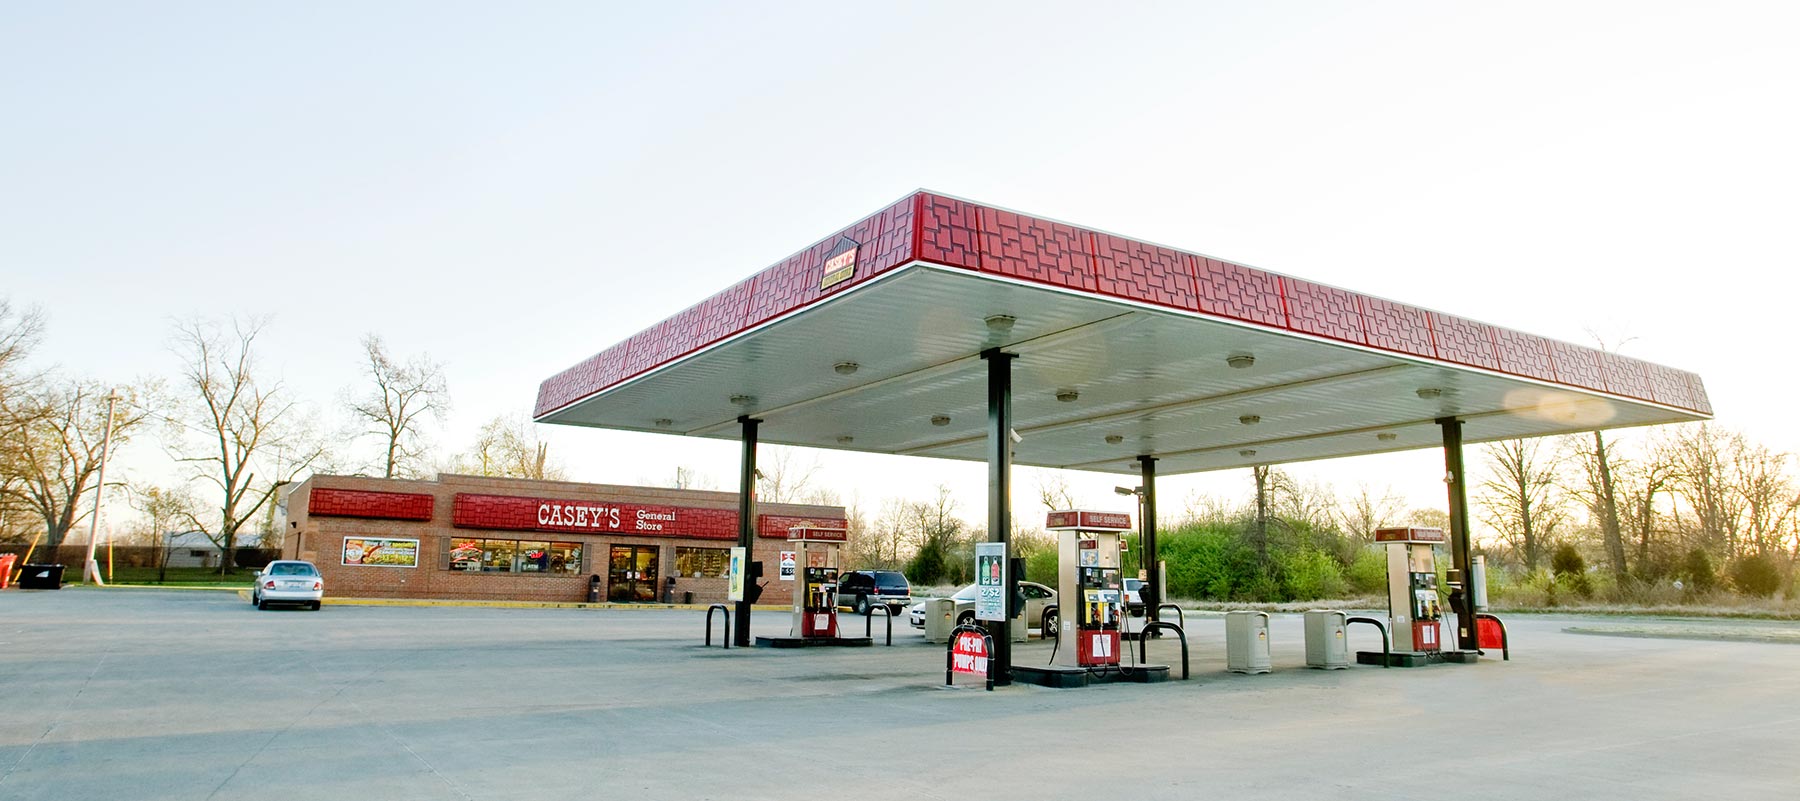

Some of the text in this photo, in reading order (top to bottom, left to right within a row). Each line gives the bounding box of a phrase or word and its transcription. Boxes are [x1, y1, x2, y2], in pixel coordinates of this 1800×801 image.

[538, 504, 620, 528] CASEY'S
[636, 509, 676, 521] General
[1089, 515, 1127, 525] SELF SERVICE
[635, 519, 663, 531] Store
